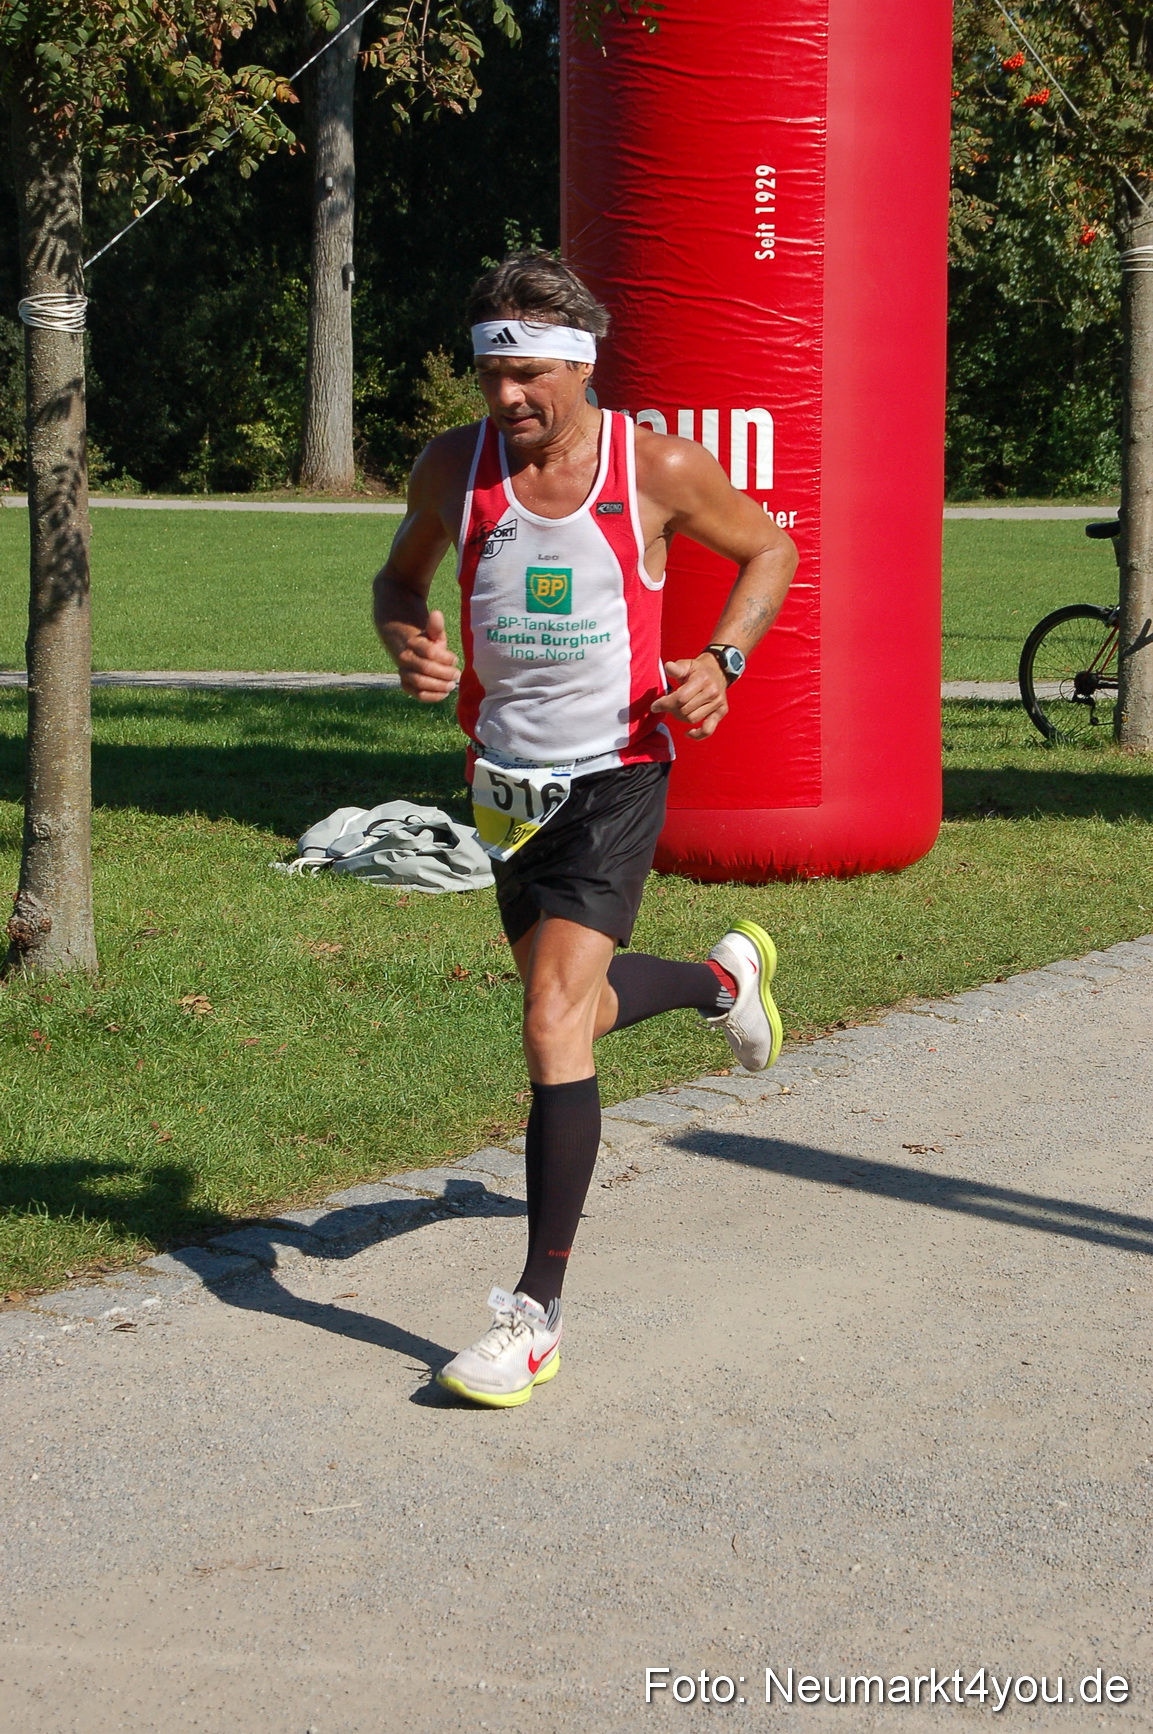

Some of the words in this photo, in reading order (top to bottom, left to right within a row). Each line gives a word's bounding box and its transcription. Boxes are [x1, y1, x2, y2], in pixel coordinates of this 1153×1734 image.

[754, 165, 776, 214] 1929
[754, 223, 775, 260] Seit
[536, 578, 564, 597] BP
[497, 616, 597, 632] BP-Tankstelle
[486, 629, 536, 645] Martin
[541, 632, 611, 648] Burghart
[510, 646, 585, 661] Ing.-Nord
[487, 769, 566, 823] 516
